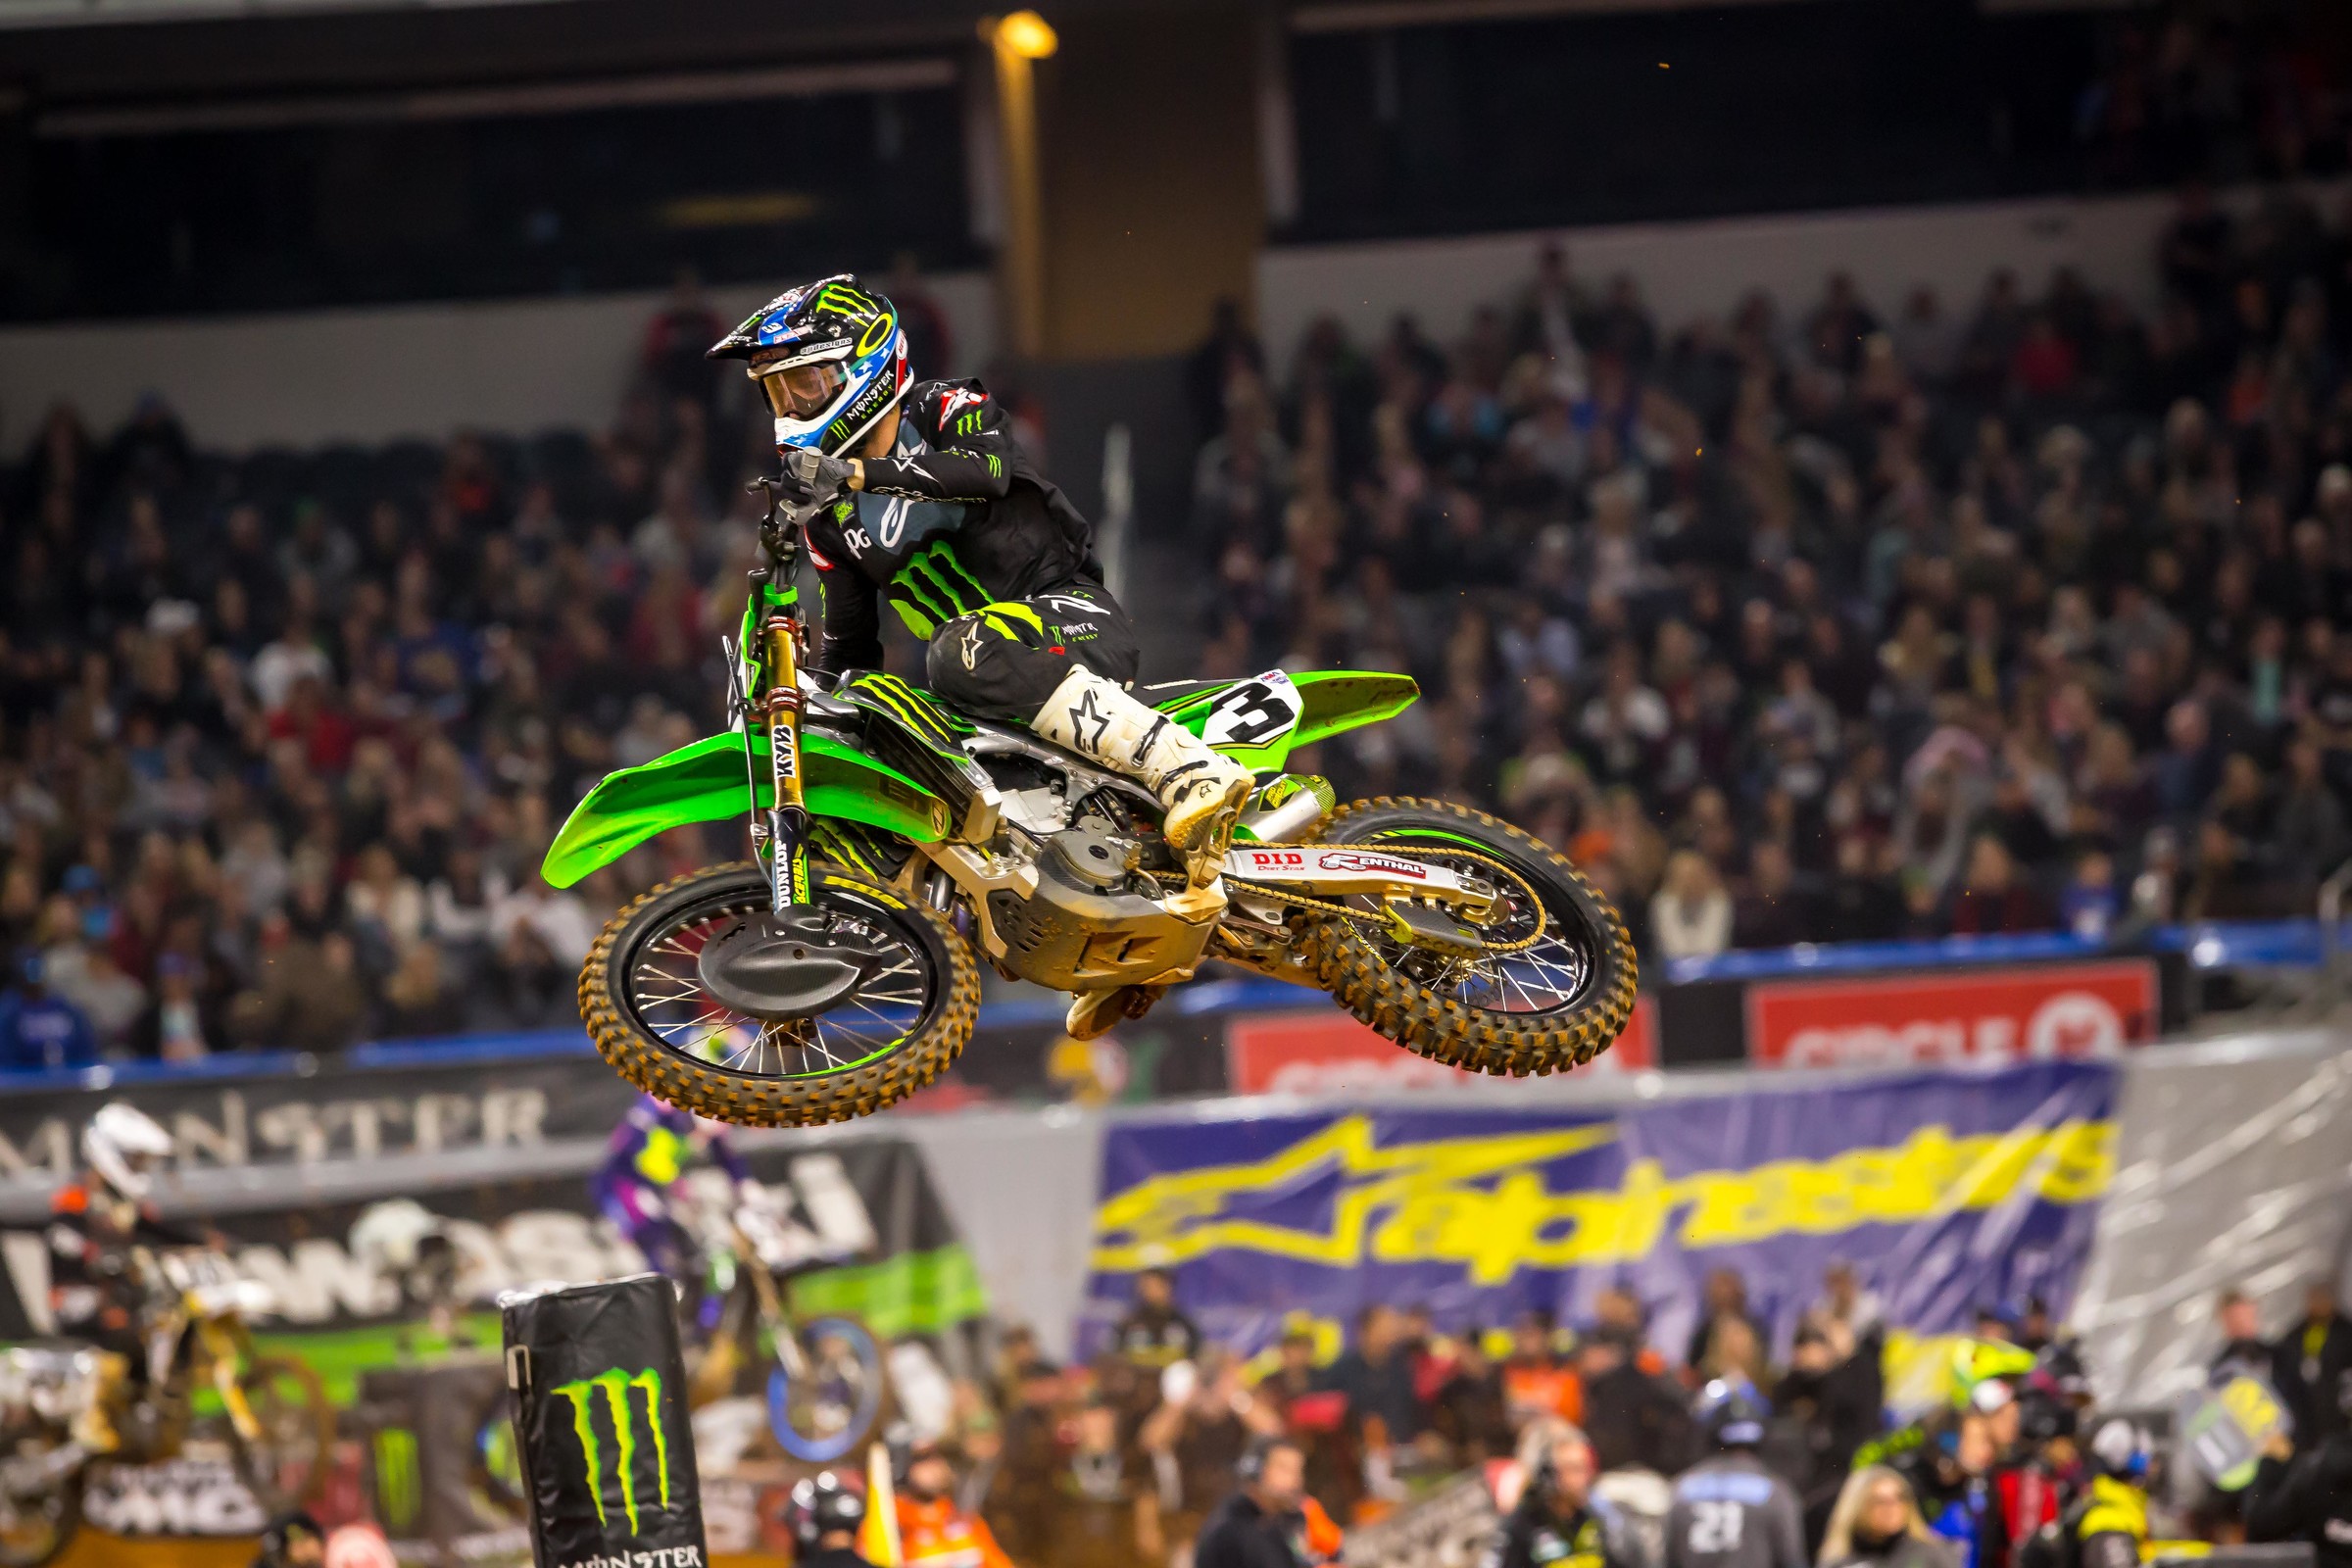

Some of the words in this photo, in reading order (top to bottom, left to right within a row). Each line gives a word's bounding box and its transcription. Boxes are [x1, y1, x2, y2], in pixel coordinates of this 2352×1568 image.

[846, 369, 894, 420] MONSTER
[1209, 683, 1296, 743] 3
[772, 725, 796, 777] KYB
[775, 840, 791, 909] DUNLOP
[793, 858, 807, 904] ACERBIS
[1323, 854, 1425, 876] RENTHAL
